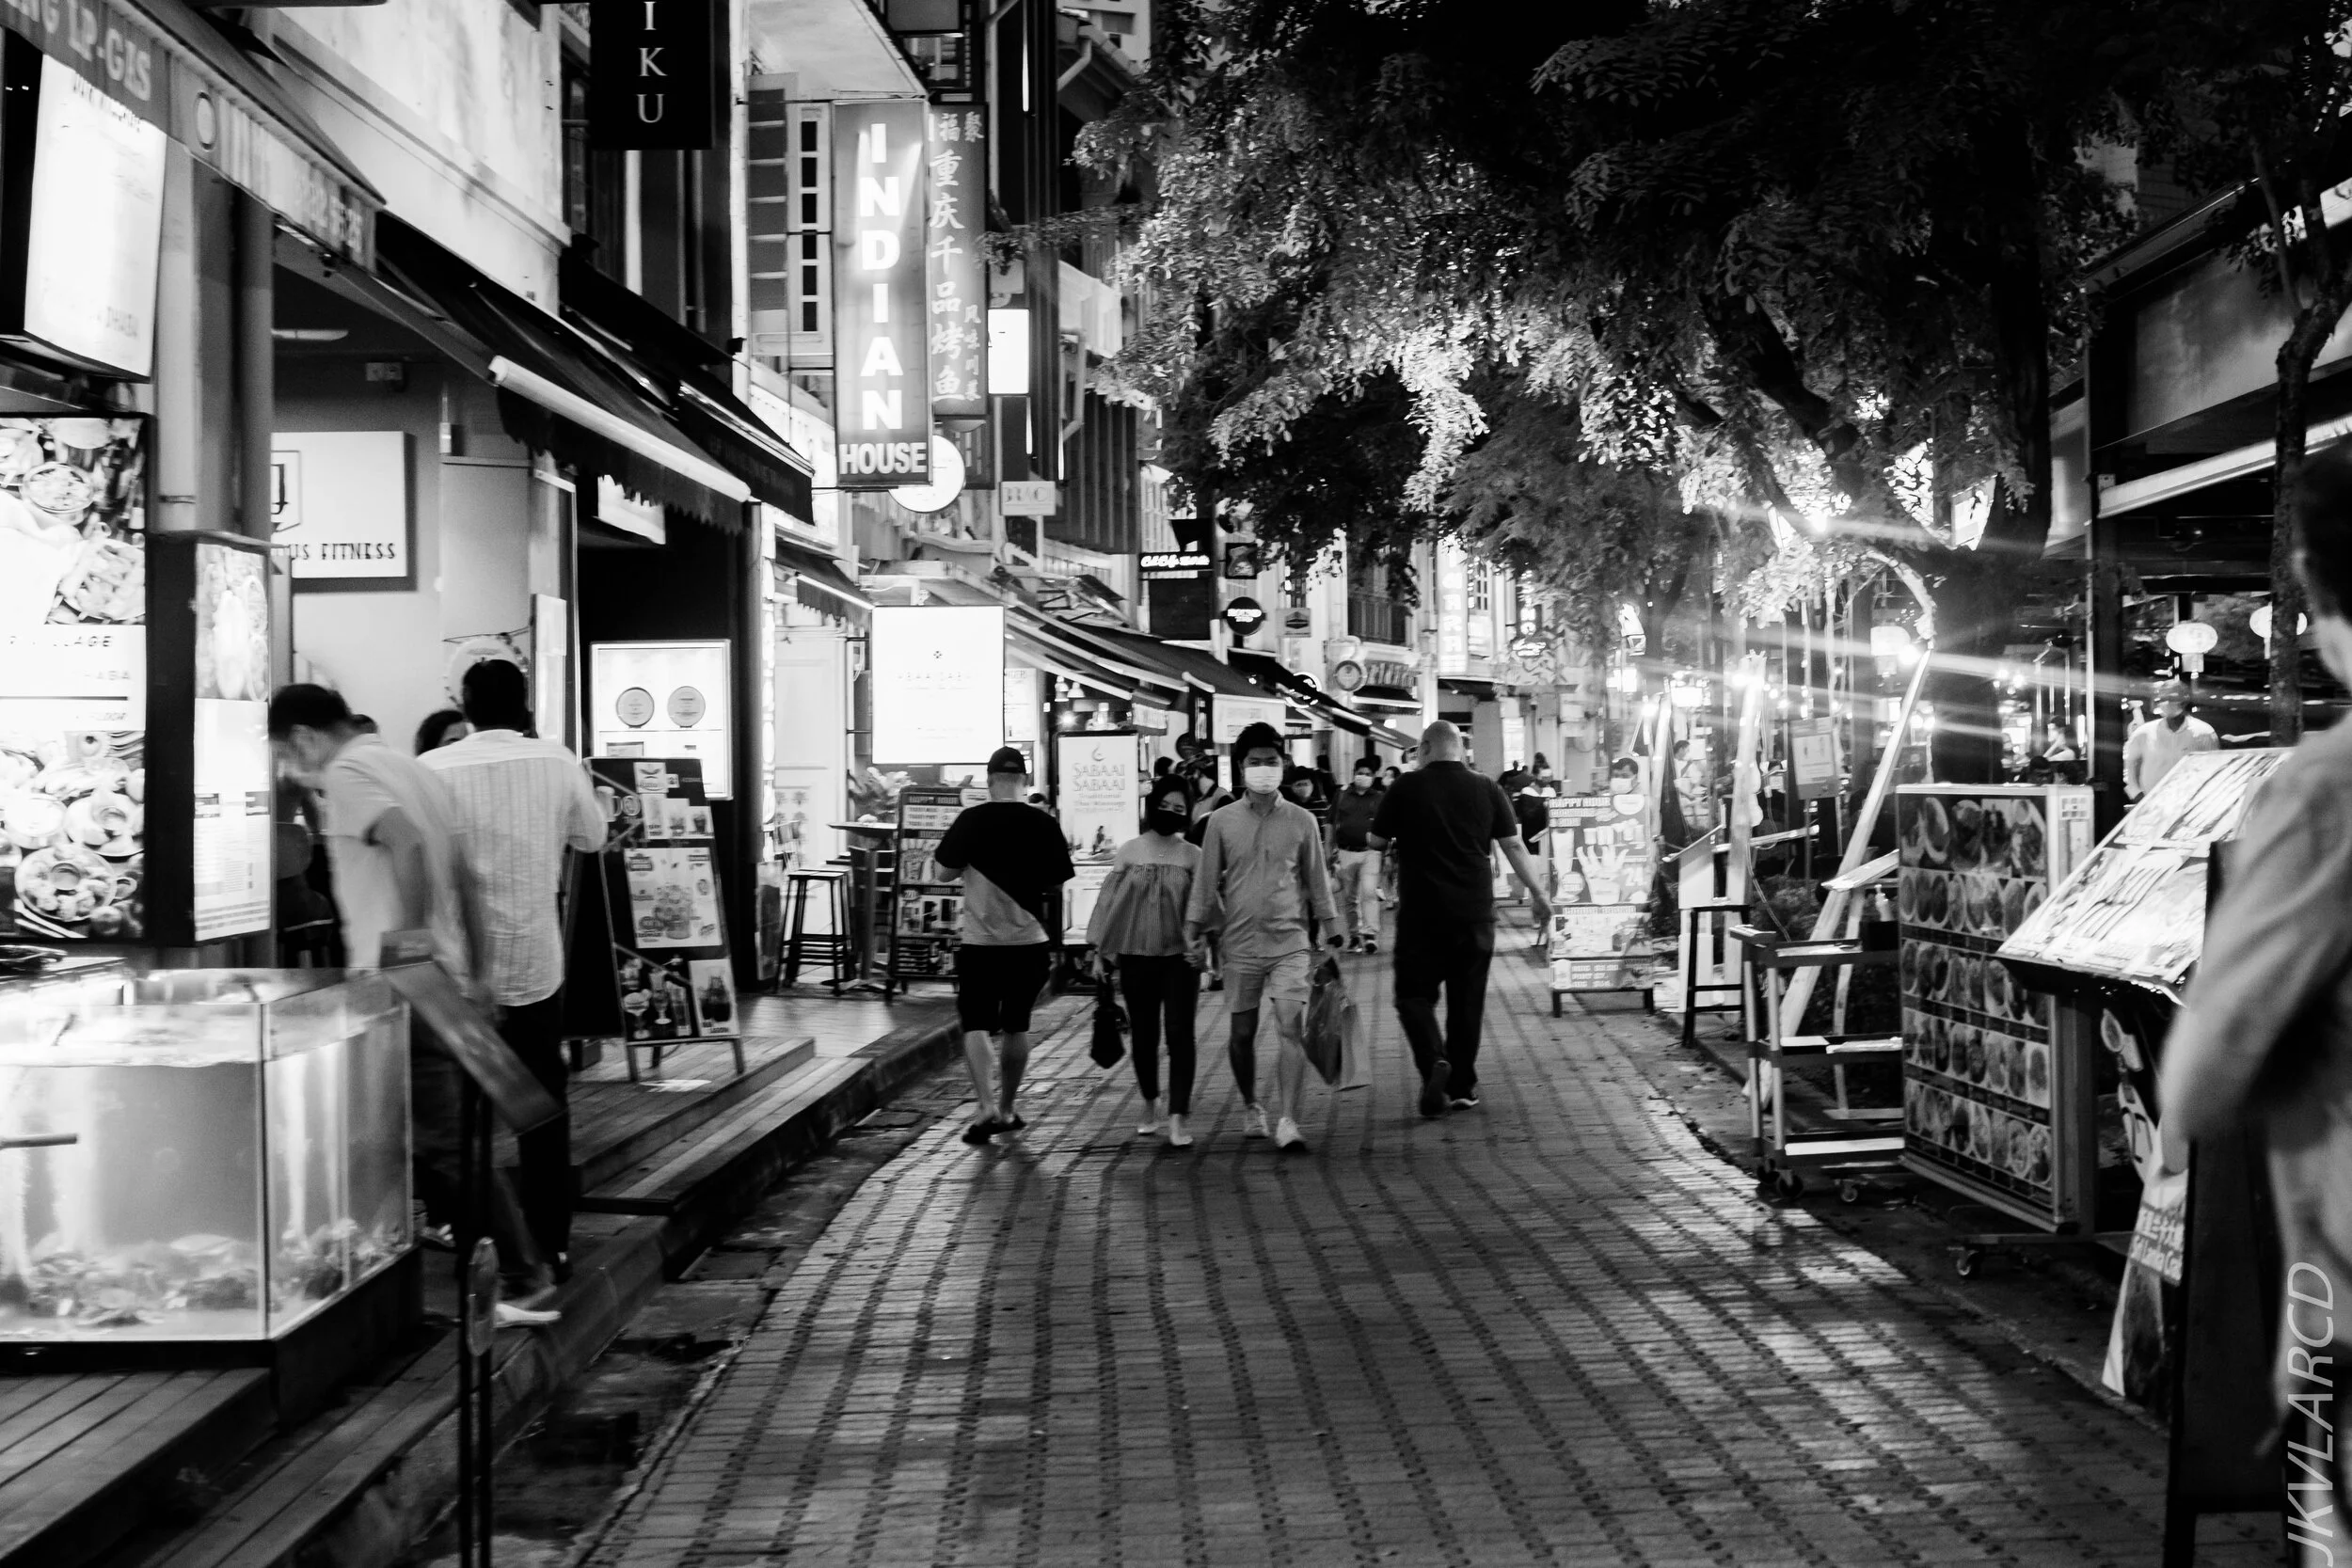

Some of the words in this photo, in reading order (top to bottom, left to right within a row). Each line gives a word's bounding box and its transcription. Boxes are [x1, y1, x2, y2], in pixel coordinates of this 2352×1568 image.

[637, 1, 668, 123] IKU
[858, 122, 904, 431] INDIAN
[843, 442, 928, 475] HOUSE
[321, 542, 395, 560] FITNESS
[1549, 797, 1582, 809] HAPPY
